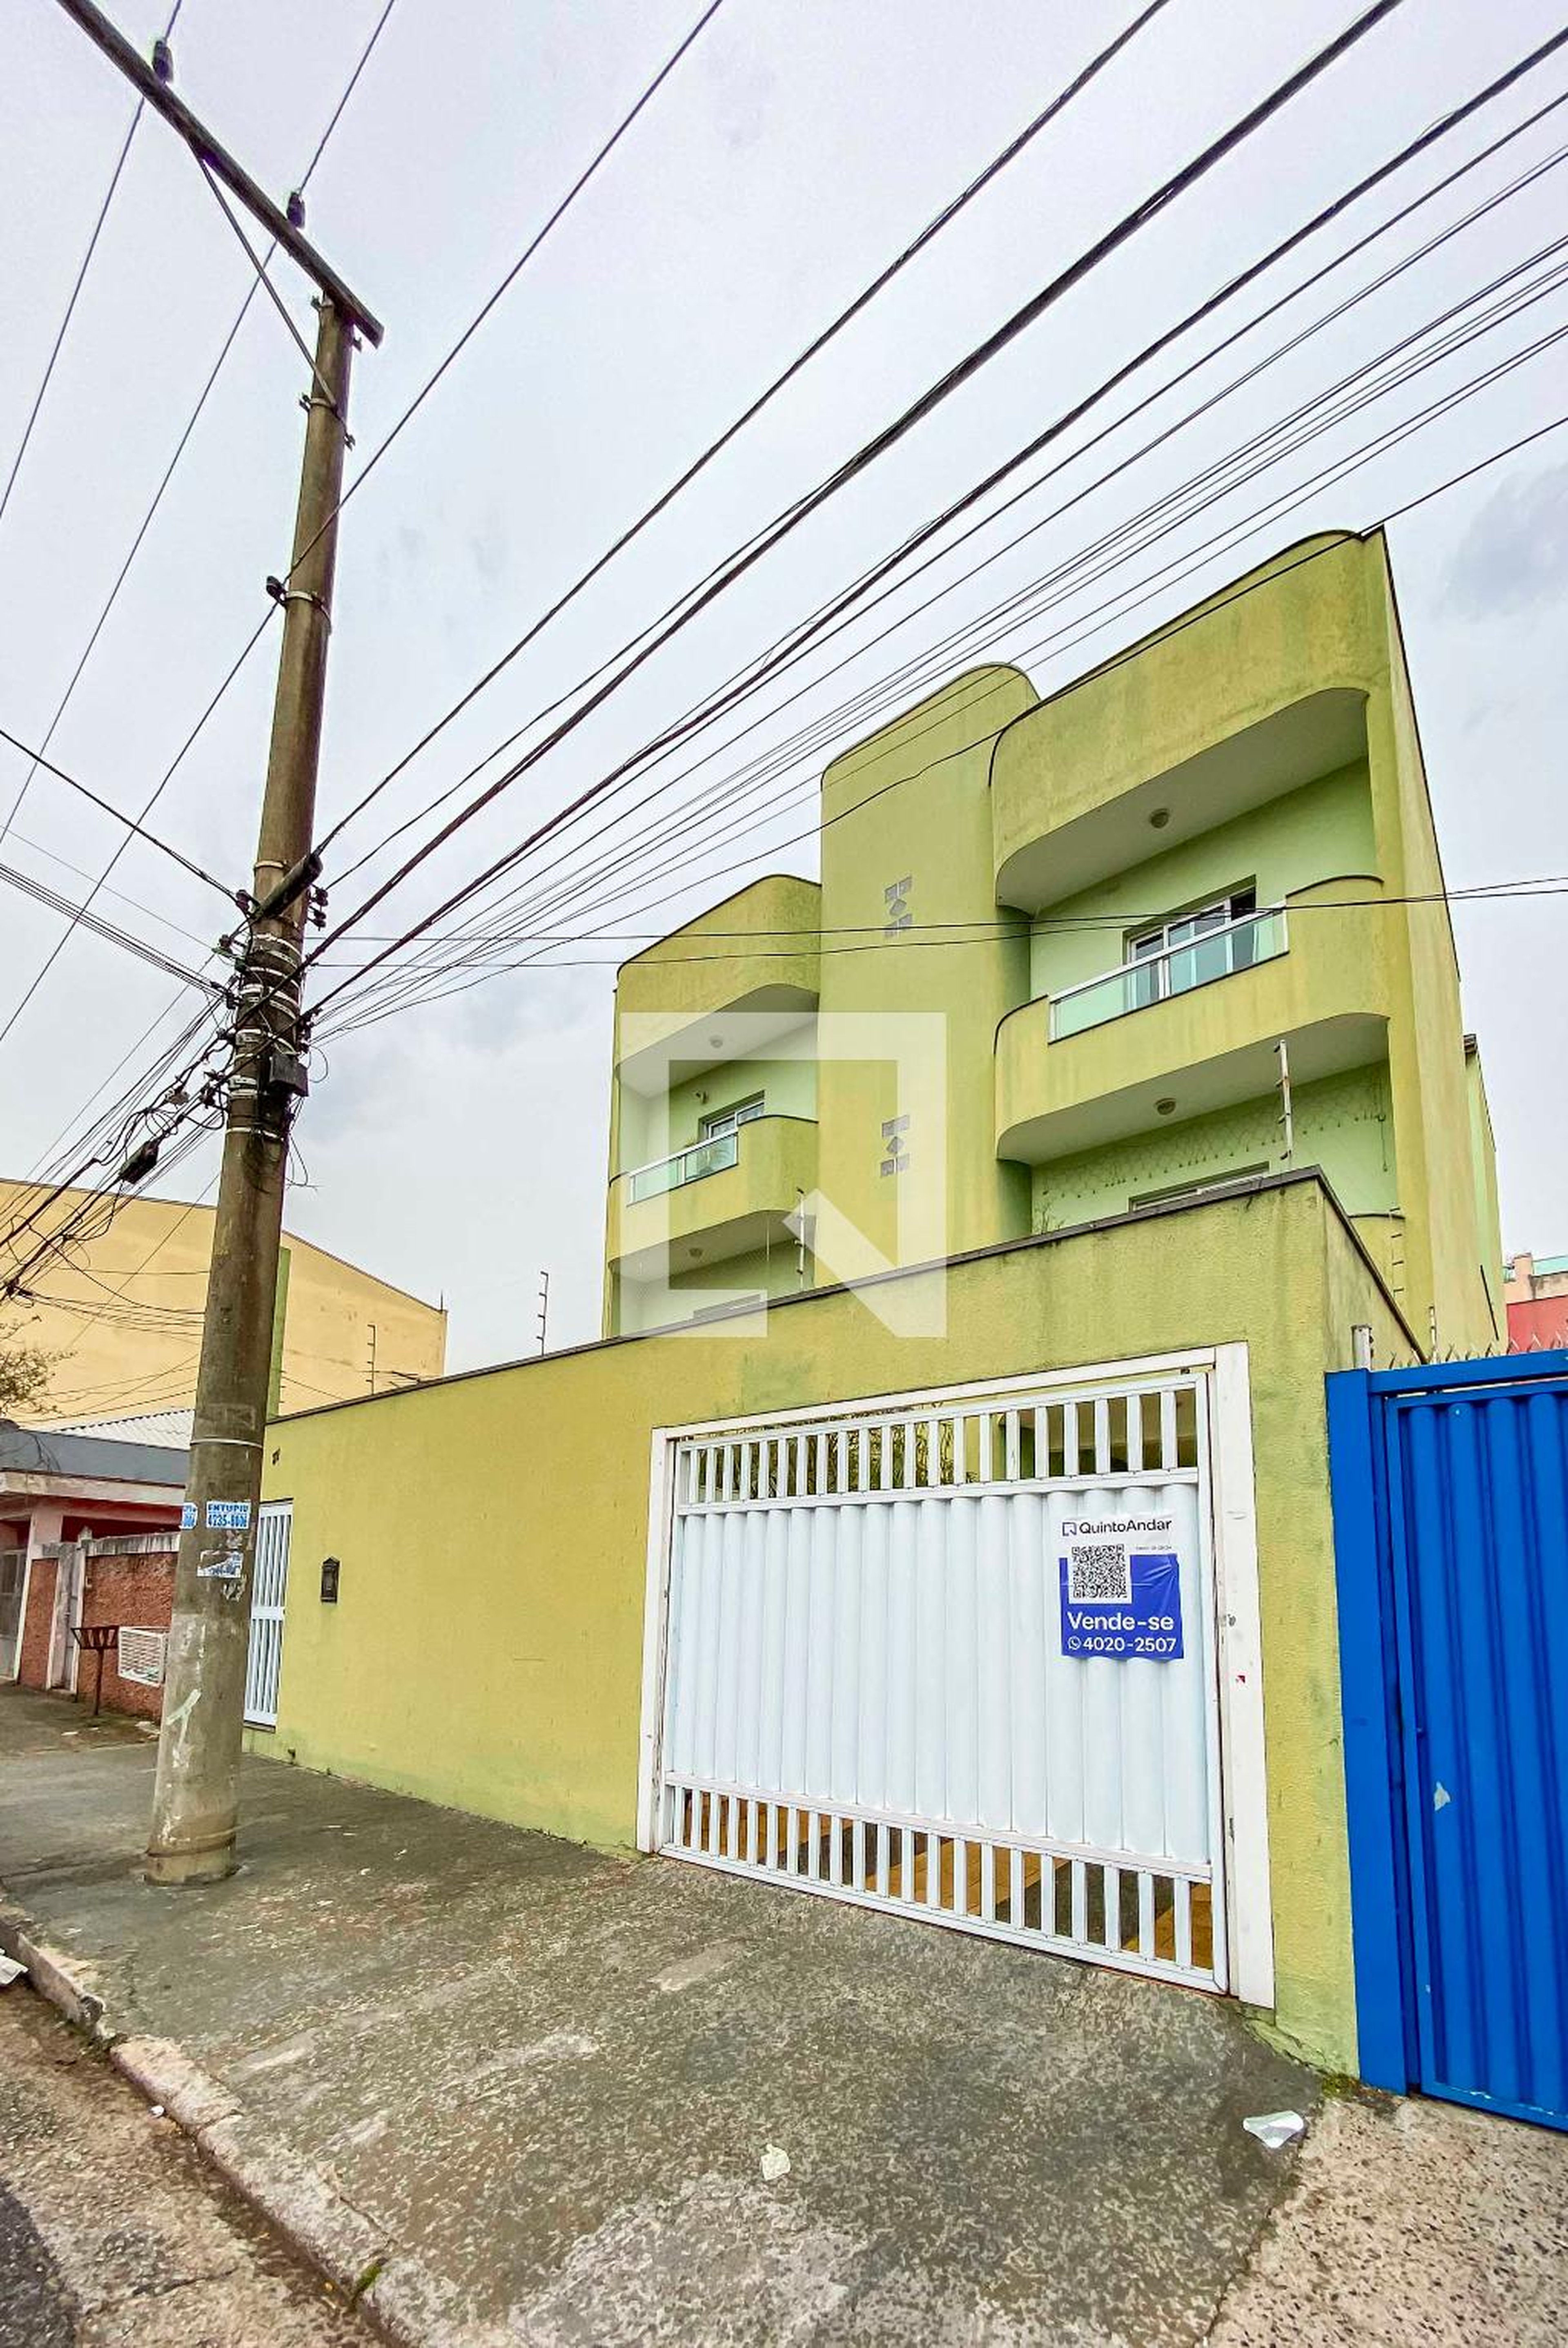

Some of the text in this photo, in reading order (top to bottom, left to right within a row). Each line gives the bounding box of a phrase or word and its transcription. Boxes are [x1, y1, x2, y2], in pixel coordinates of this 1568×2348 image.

[1079, 1519, 1172, 1534] QuintoAndar
[1067, 1611, 1174, 1630] Vende-se
[1082, 1637, 1176, 1652] 4020-2507
